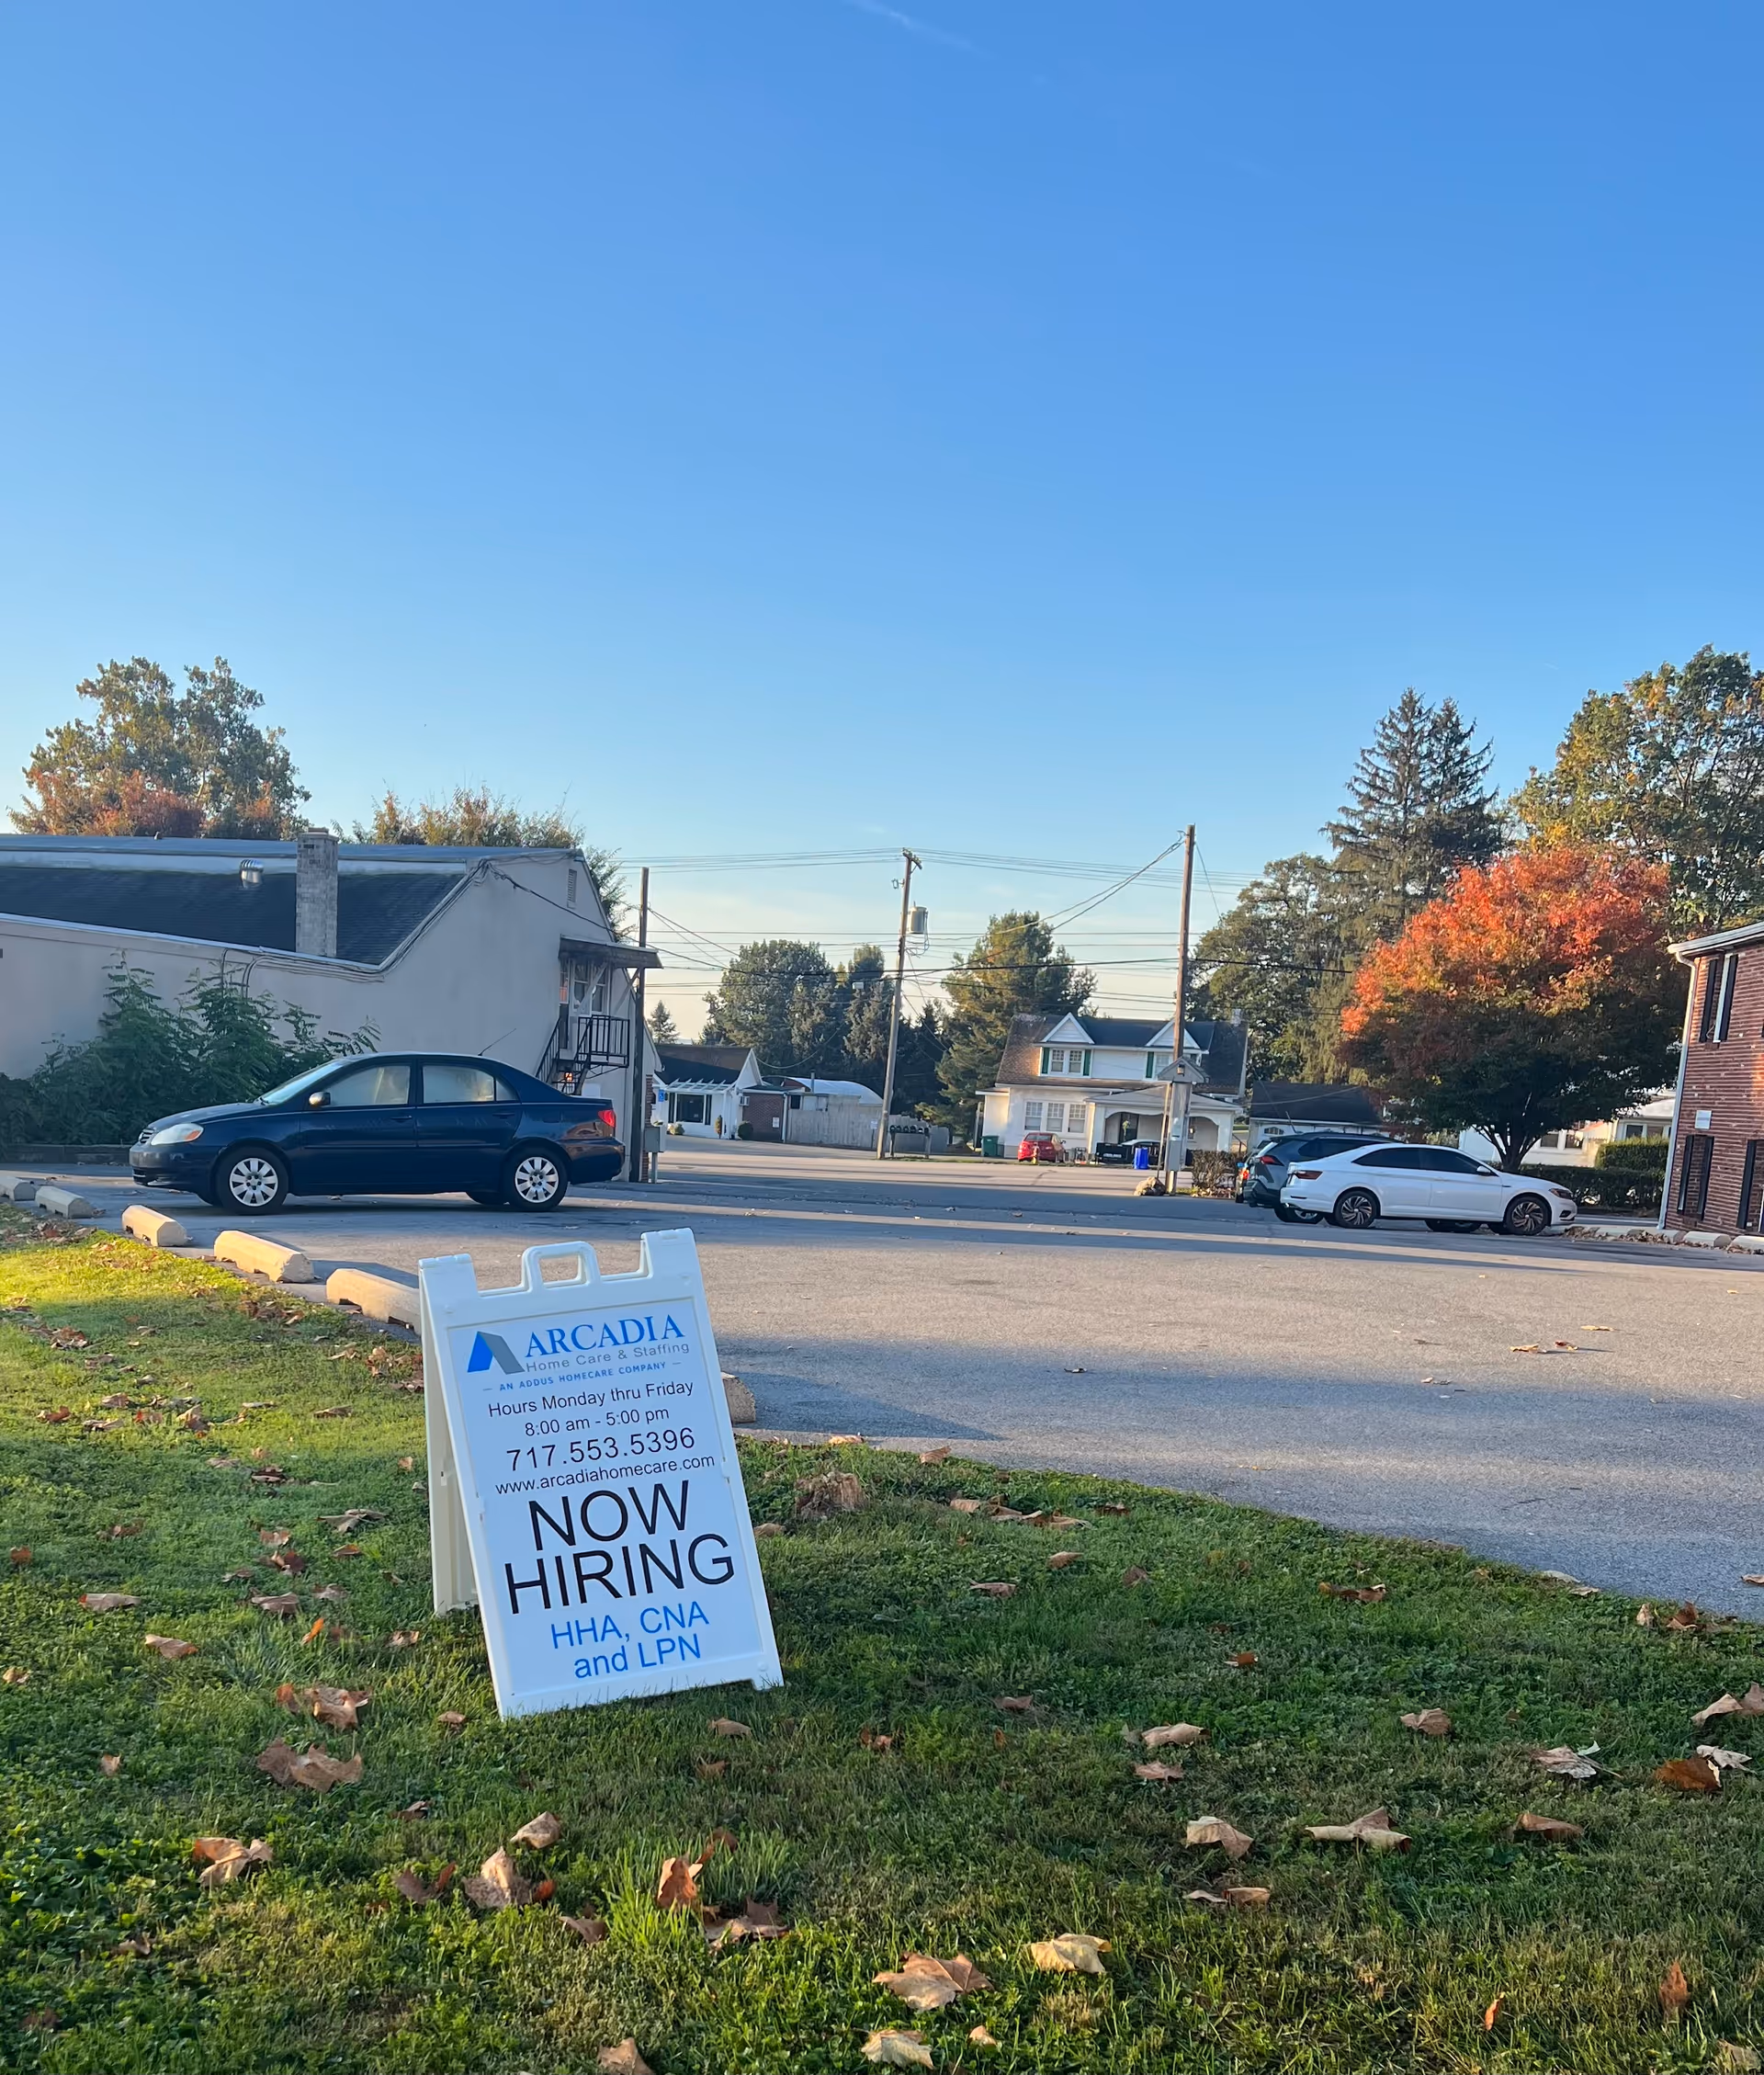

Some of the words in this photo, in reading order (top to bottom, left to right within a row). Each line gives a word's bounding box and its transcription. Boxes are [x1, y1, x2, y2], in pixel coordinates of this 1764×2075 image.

[525, 1314, 685, 1357] ARCADIA
[499, 1382, 514, 1391] AN
[519, 1377, 554, 1389] ADDUS
[559, 1368, 613, 1383] HOMECARE
[618, 1362, 666, 1375] COMPANY
[526, 1359, 570, 1373] Home
[576, 1354, 612, 1366] Care
[617, 1349, 628, 1360] &
[633, 1343, 690, 1358] Staffing
[488, 1400, 537, 1418] Hours
[542, 1390, 605, 1411] Monday
[610, 1387, 641, 1402] thru
[645, 1381, 694, 1398] Friday
[525, 1419, 560, 1436] 8:00
[565, 1419, 590, 1432] am
[605, 1409, 640, 1426] 5:00
[645, 1408, 670, 1424] pm
[506, 1427, 695, 1471] 717.553.5396
[495, 1455, 716, 1495] www.arcadiahomecare.com
[528, 1480, 689, 1551] NOW
[504, 1533, 735, 1615] HIRING
[551, 1615, 630, 1650] HHA,
[639, 1601, 709, 1635] CNA
[574, 1645, 628, 1679] and
[638, 1633, 701, 1668] LPN
